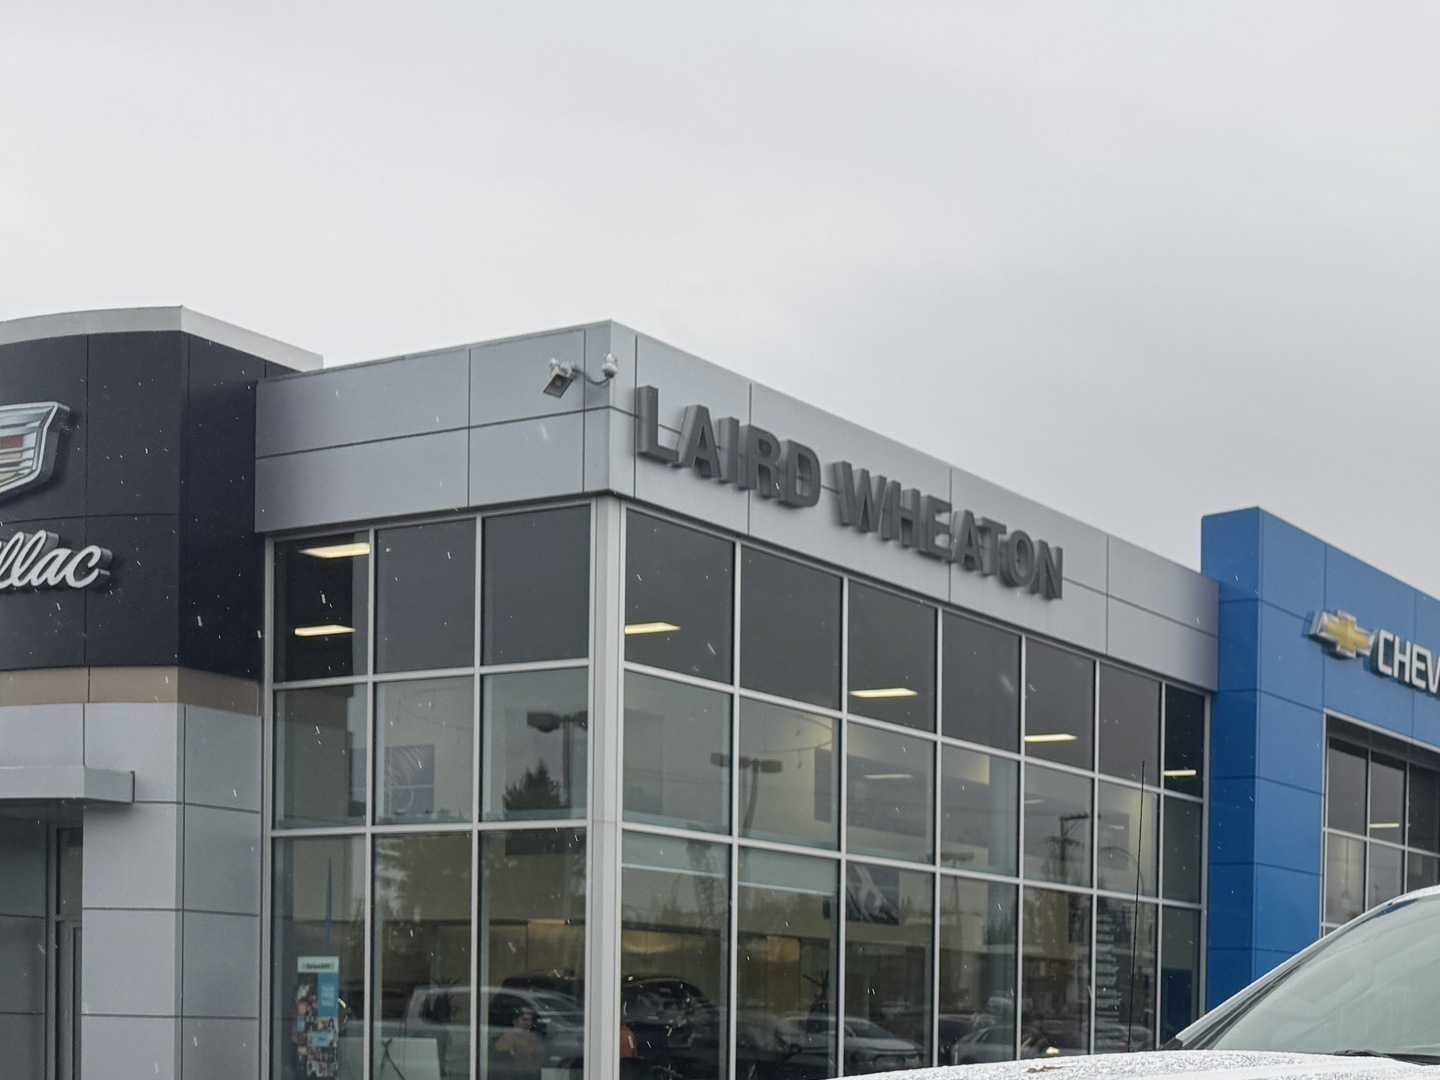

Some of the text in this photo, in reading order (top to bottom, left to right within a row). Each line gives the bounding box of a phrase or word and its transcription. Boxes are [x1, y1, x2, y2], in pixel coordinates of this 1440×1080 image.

[0, 529, 109, 589] llac
[638, 385, 1063, 600] LAIRD WHEATON
